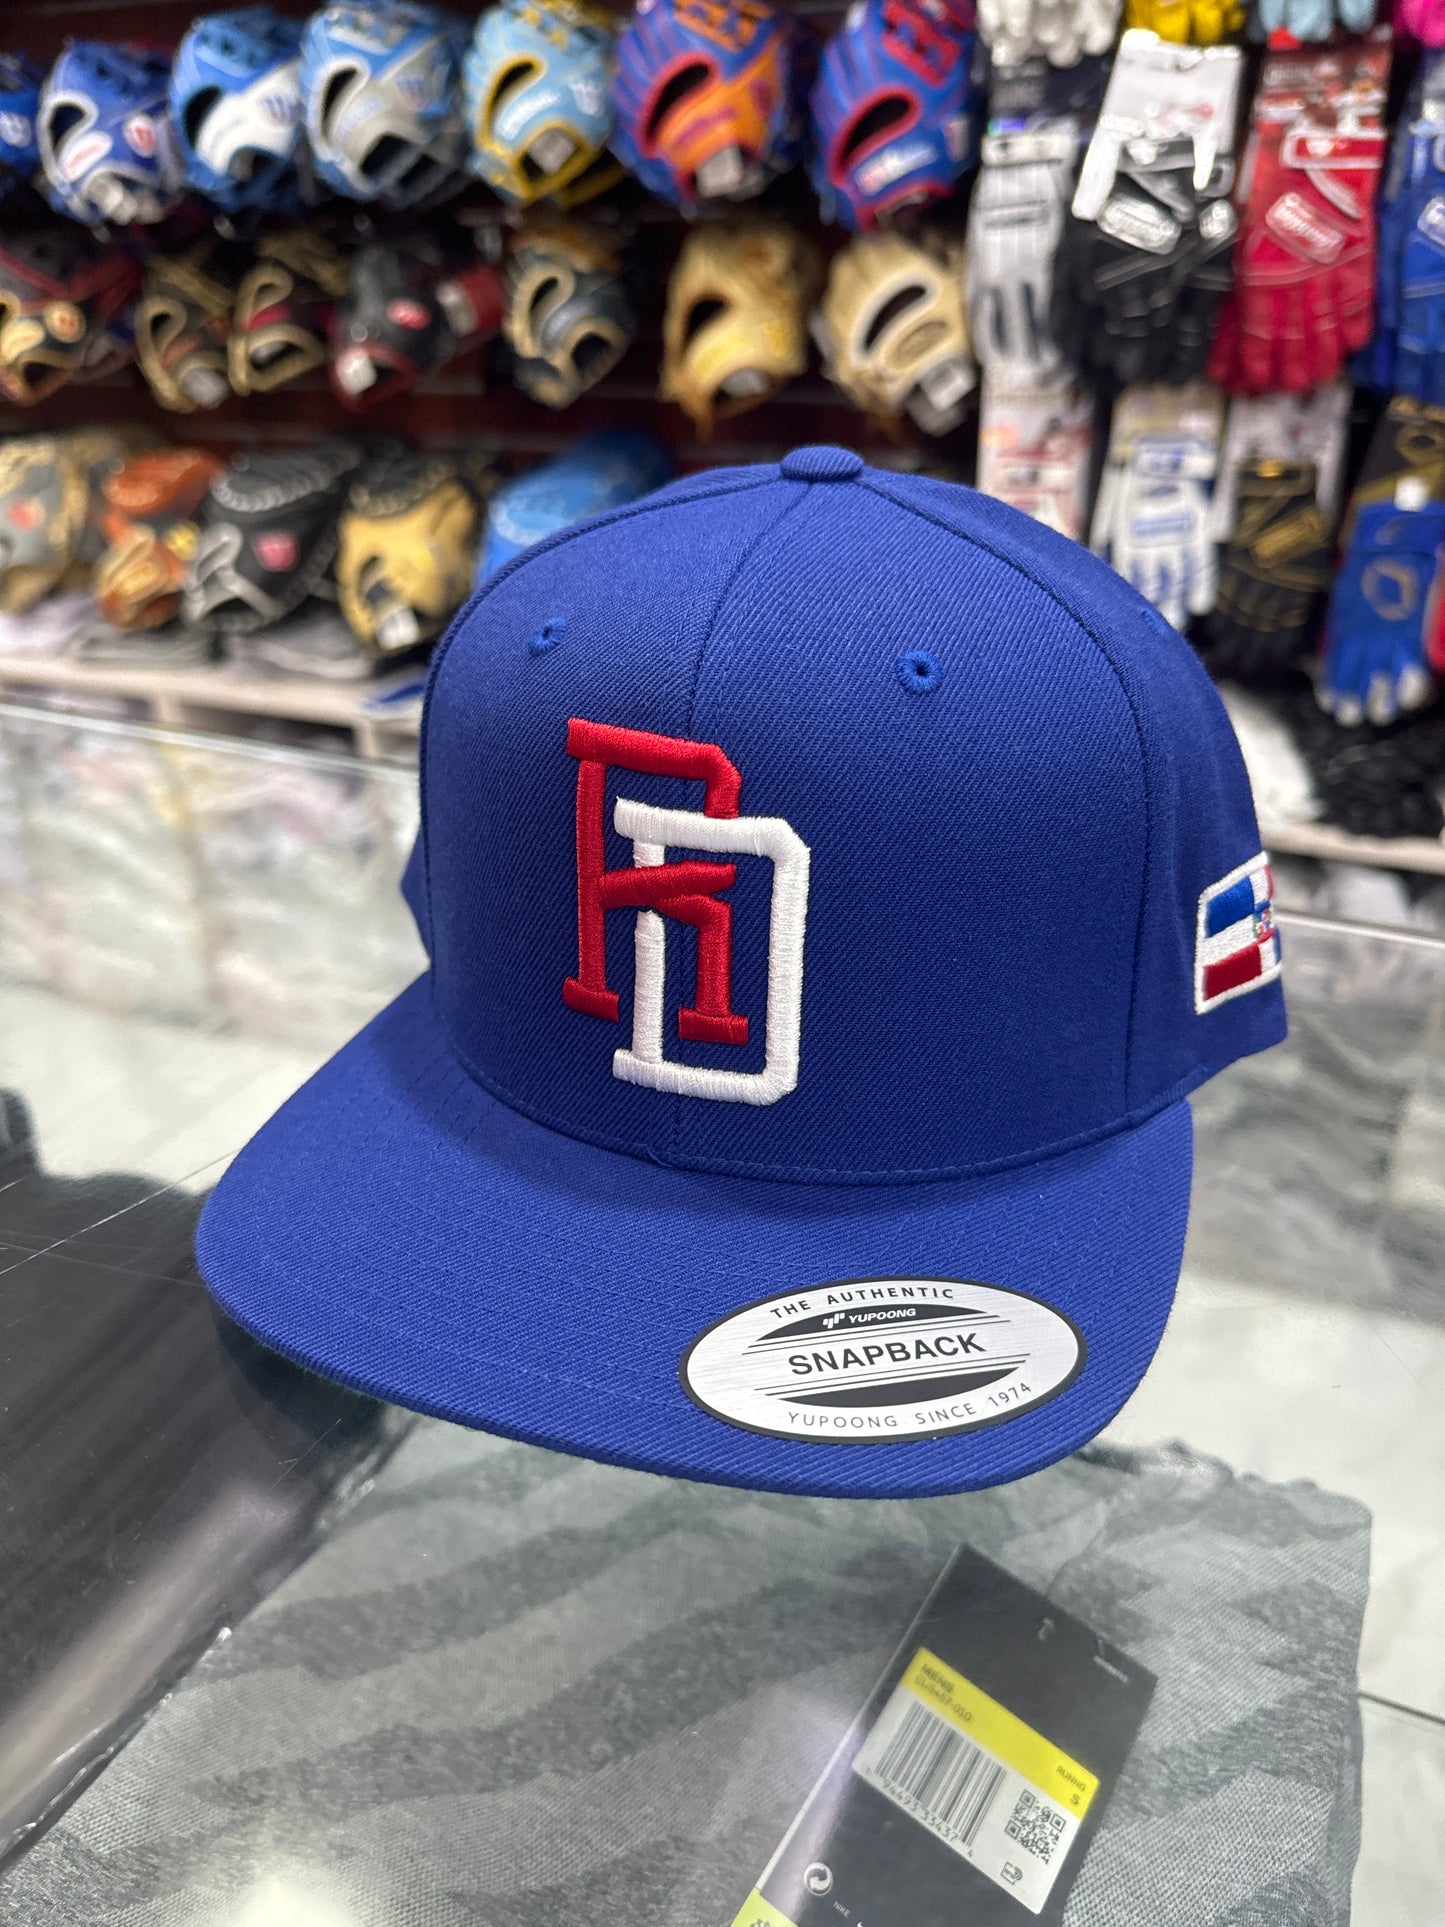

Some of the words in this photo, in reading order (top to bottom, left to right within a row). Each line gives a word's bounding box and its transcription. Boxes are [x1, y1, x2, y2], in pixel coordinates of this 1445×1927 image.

[770, 1300, 811, 1319] THE
[827, 1287, 954, 1305] AUTHENTIC
[848, 1307, 916, 1324] YUPOONG
[788, 1333, 987, 1375] SNAPBACK
[788, 1411, 898, 1429] YUPOONG
[915, 1402, 977, 1425] SINCE
[988, 1382, 1032, 1408] 1974
[833, 1901, 850, 1917] NIKE
